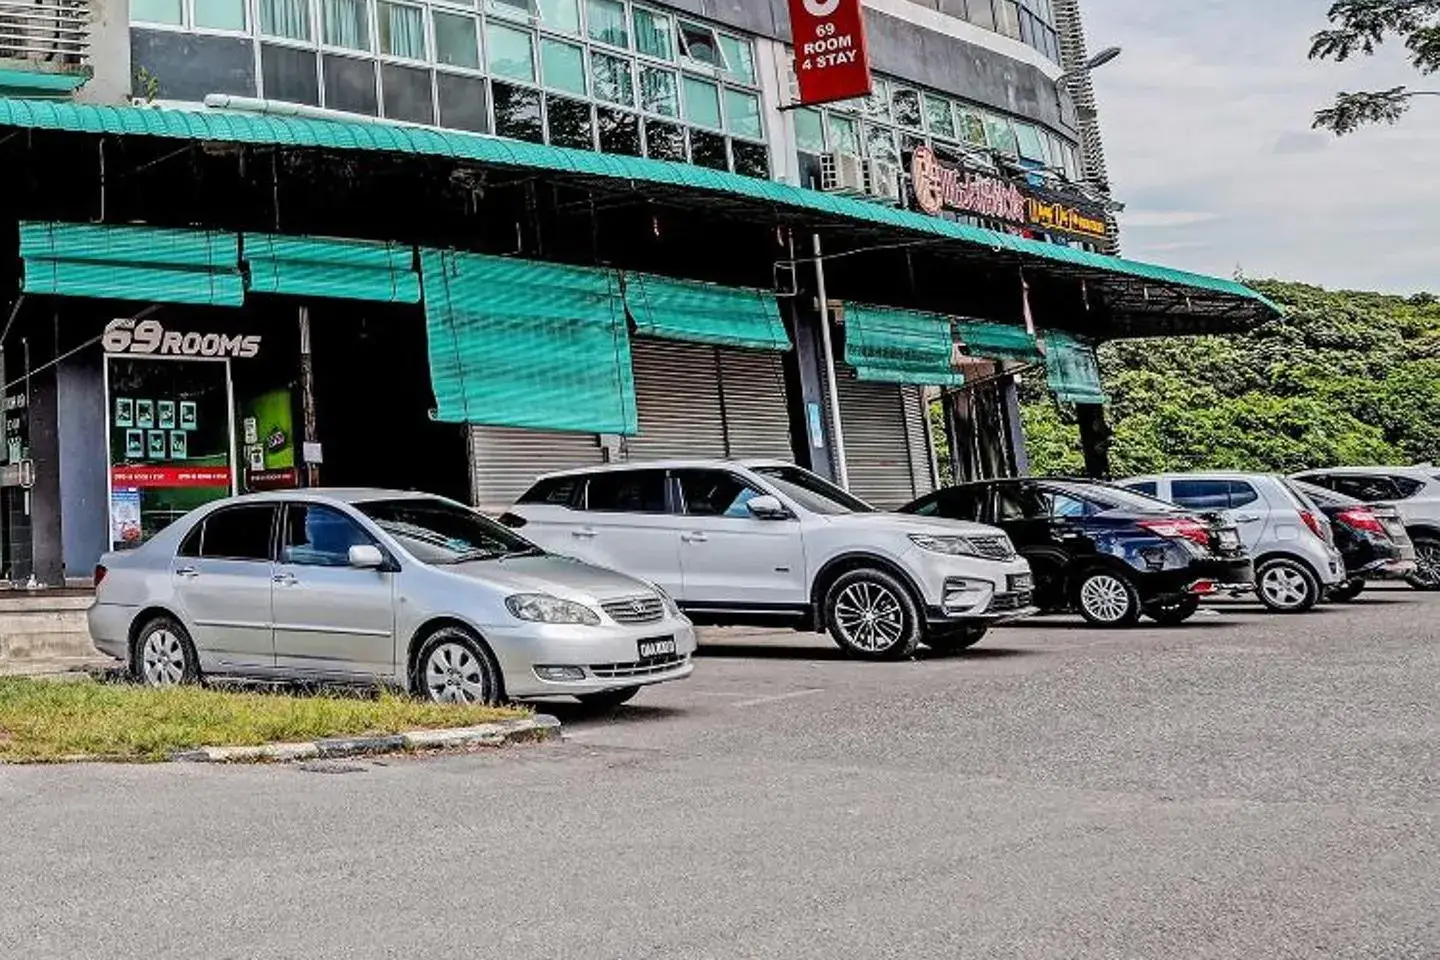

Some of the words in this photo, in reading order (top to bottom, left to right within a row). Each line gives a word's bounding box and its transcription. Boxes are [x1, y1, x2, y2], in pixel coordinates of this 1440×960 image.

[815, 22, 835, 37] 69
[803, 34, 852, 55] ROOM
[802, 59, 812, 70] 4
[816, 49, 857, 68] STAY
